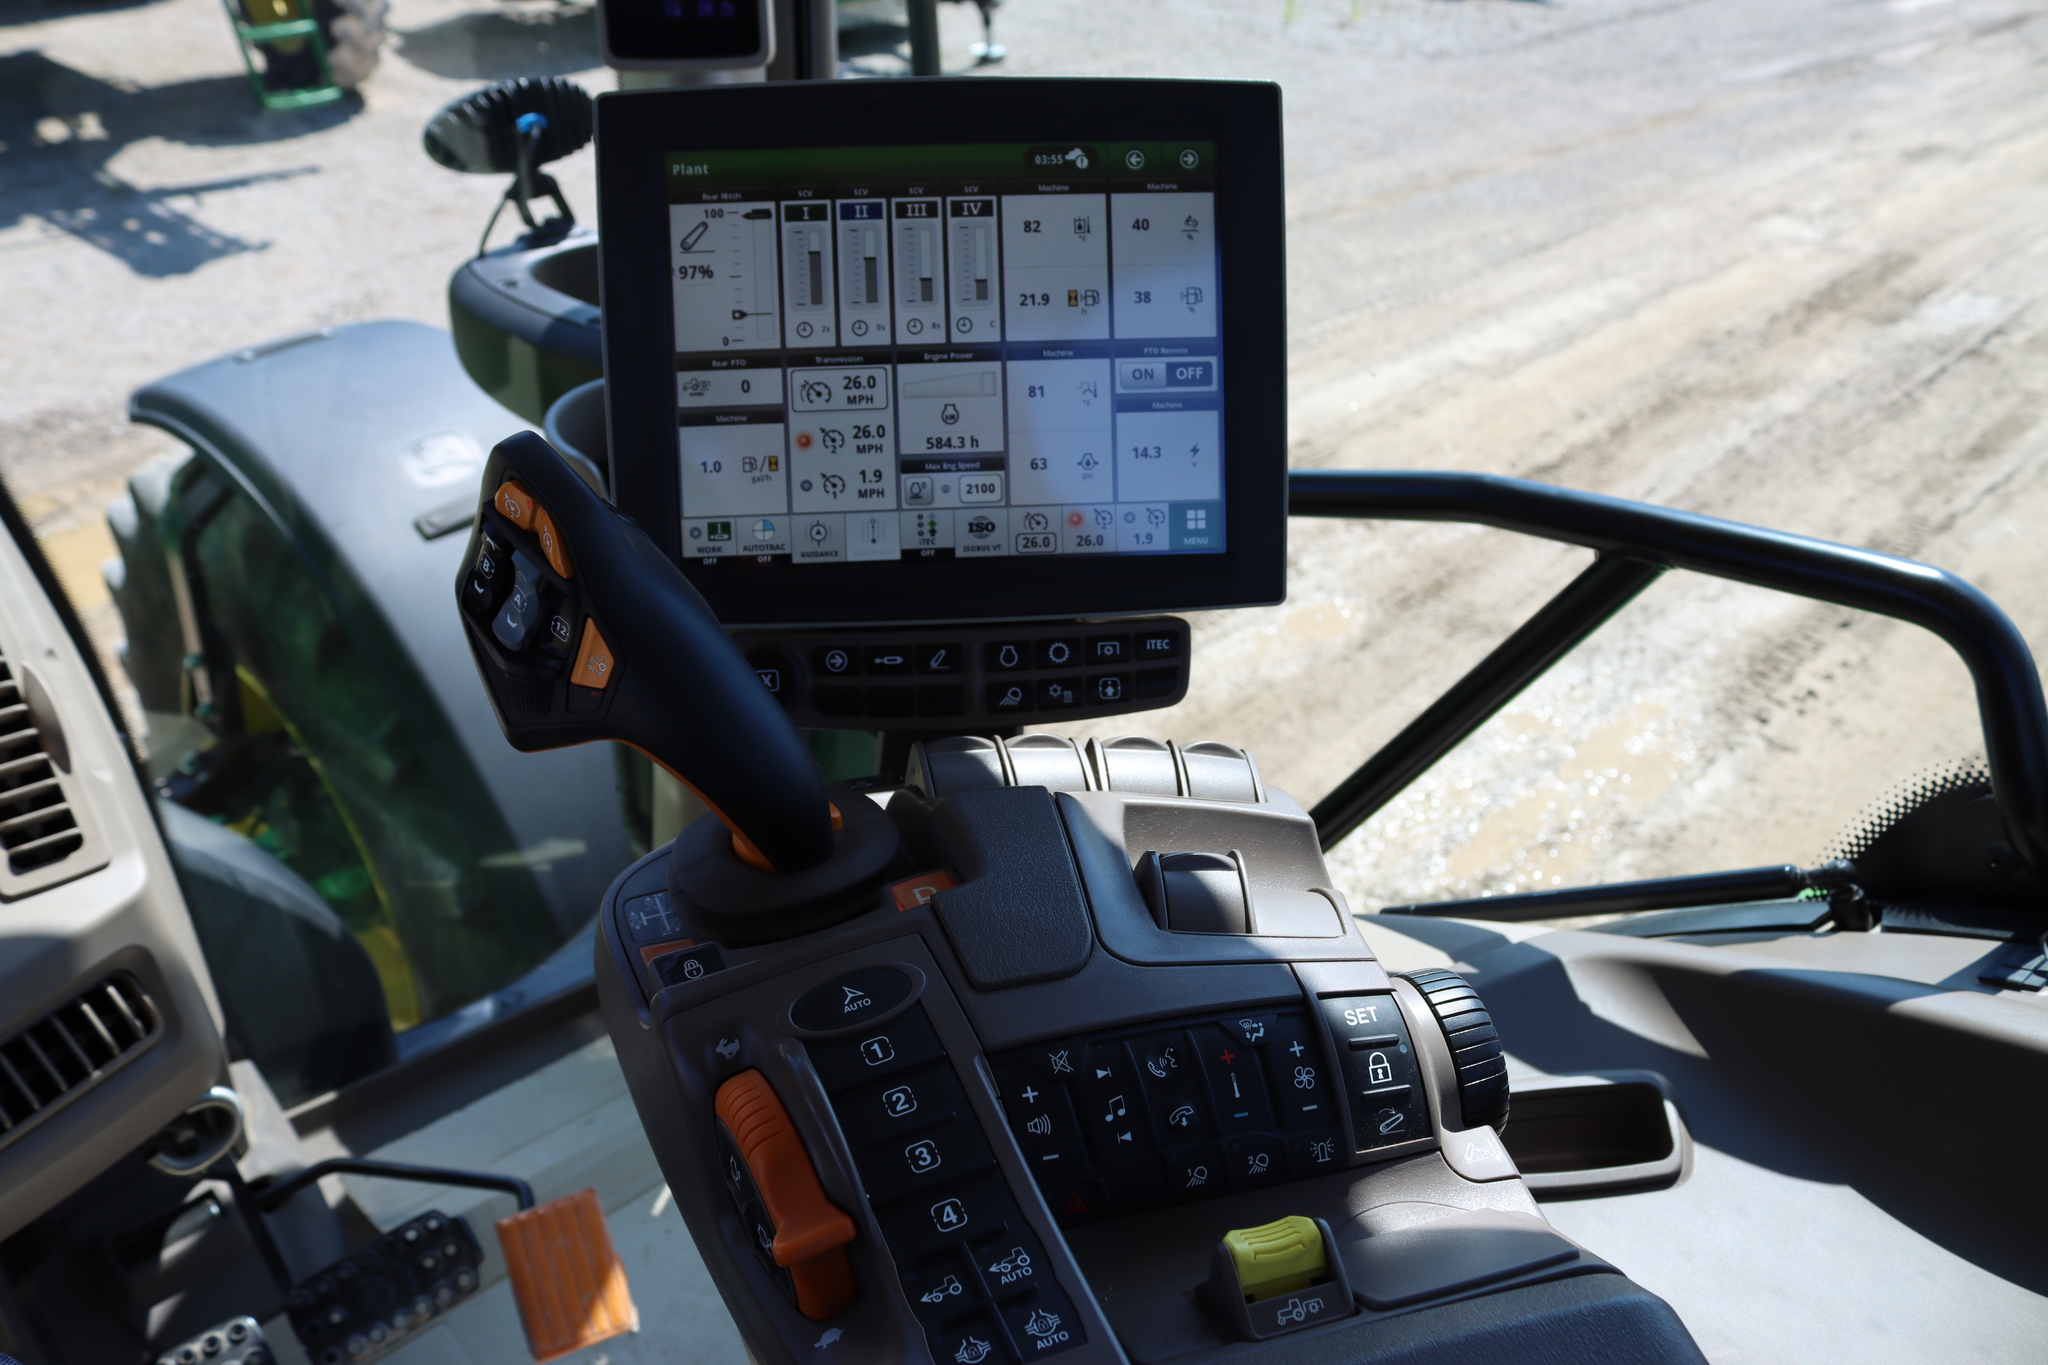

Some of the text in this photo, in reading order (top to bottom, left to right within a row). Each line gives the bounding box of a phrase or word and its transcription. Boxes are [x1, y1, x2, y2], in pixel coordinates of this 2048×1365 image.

[1034, 154, 1063, 165] 03:55
[672, 164, 709, 175] Plant
[909, 187, 924, 195] SCV
[1038, 184, 1069, 192] Machine
[1147, 182, 1178, 190] Machine
[721, 192, 742, 200] Hitch
[854, 188, 868, 196] SCV
[704, 208, 724, 218] 100
[802, 206, 810, 219] I
[855, 205, 868, 218] II
[906, 204, 927, 216] III
[962, 202, 982, 215] IV
[1023, 220, 1041, 233] 82
[1132, 218, 1150, 231] 40
[679, 264, 714, 280] 97%
[1019, 293, 1050, 306] 21.9
[1134, 291, 1152, 304] 38
[1081, 307, 1087, 315] h
[722, 336, 729, 346] 0
[1043, 349, 1074, 357] Machine
[1161, 346, 1188, 354] Remote
[815, 355, 863, 364] Transmission
[924, 352, 948, 360] Engine
[1132, 368, 1154, 381] ON
[1176, 367, 1203, 380] OFF
[741, 380, 750, 393] 0
[843, 375, 876, 390] 26.0
[1028, 385, 1045, 398] 81
[847, 394, 874, 405] MPH
[1152, 401, 1183, 409] Machine
[716, 414, 747, 422] Machine
[852, 424, 885, 439] 26.0
[926, 436, 979, 450] 584.3 h
[831, 445, 837, 454] 2
[856, 444, 883, 454] MPH
[1132, 446, 1162, 459] 14.3
[700, 461, 722, 474] 1.0
[943, 462, 956, 471] Eng
[958, 461, 980, 470] Speed
[1030, 457, 1047, 470] 63
[751, 474, 772, 484] gal/h
[858, 469, 883, 483] 1.9
[1082, 472, 1094, 481] psi
[858, 488, 885, 499] MPH
[966, 483, 995, 494] 2100
[832, 491, 837, 499] 1
[968, 522, 995, 533] ISO
[919, 538, 936, 546] iTEC
[1022, 536, 1050, 549] 26.0
[1076, 535, 1104, 547] 26.0
[1134, 533, 1153, 545] 1.9
[1184, 537, 1209, 545] MENU
[696, 546, 723, 554] WORK
[742, 543, 785, 552] AUTOTRAC
[920, 549, 935, 557] OFF
[758, 555, 772, 563] OFF
[800, 550, 838, 558] GUIDANCE
[483, 560, 490, 572] B
[703, 557, 717, 565] OFF
[513, 594, 521, 605] A
[556, 622, 567, 635] 12
[1147, 639, 1169, 650] iTEC
[844, 998, 871, 1013] AUTO
[1344, 1005, 1379, 1027] SET
[870, 1043, 883, 1058] 1
[892, 1094, 906, 1110] 2
[915, 1147, 932, 1166] 3
[1248, 1156, 1255, 1166] 2
[1187, 1168, 1193, 1179] 1
[942, 1206, 958, 1224] 4
[1001, 1266, 1032, 1285] AUTO
[1037, 1331, 1069, 1350] AUTO
